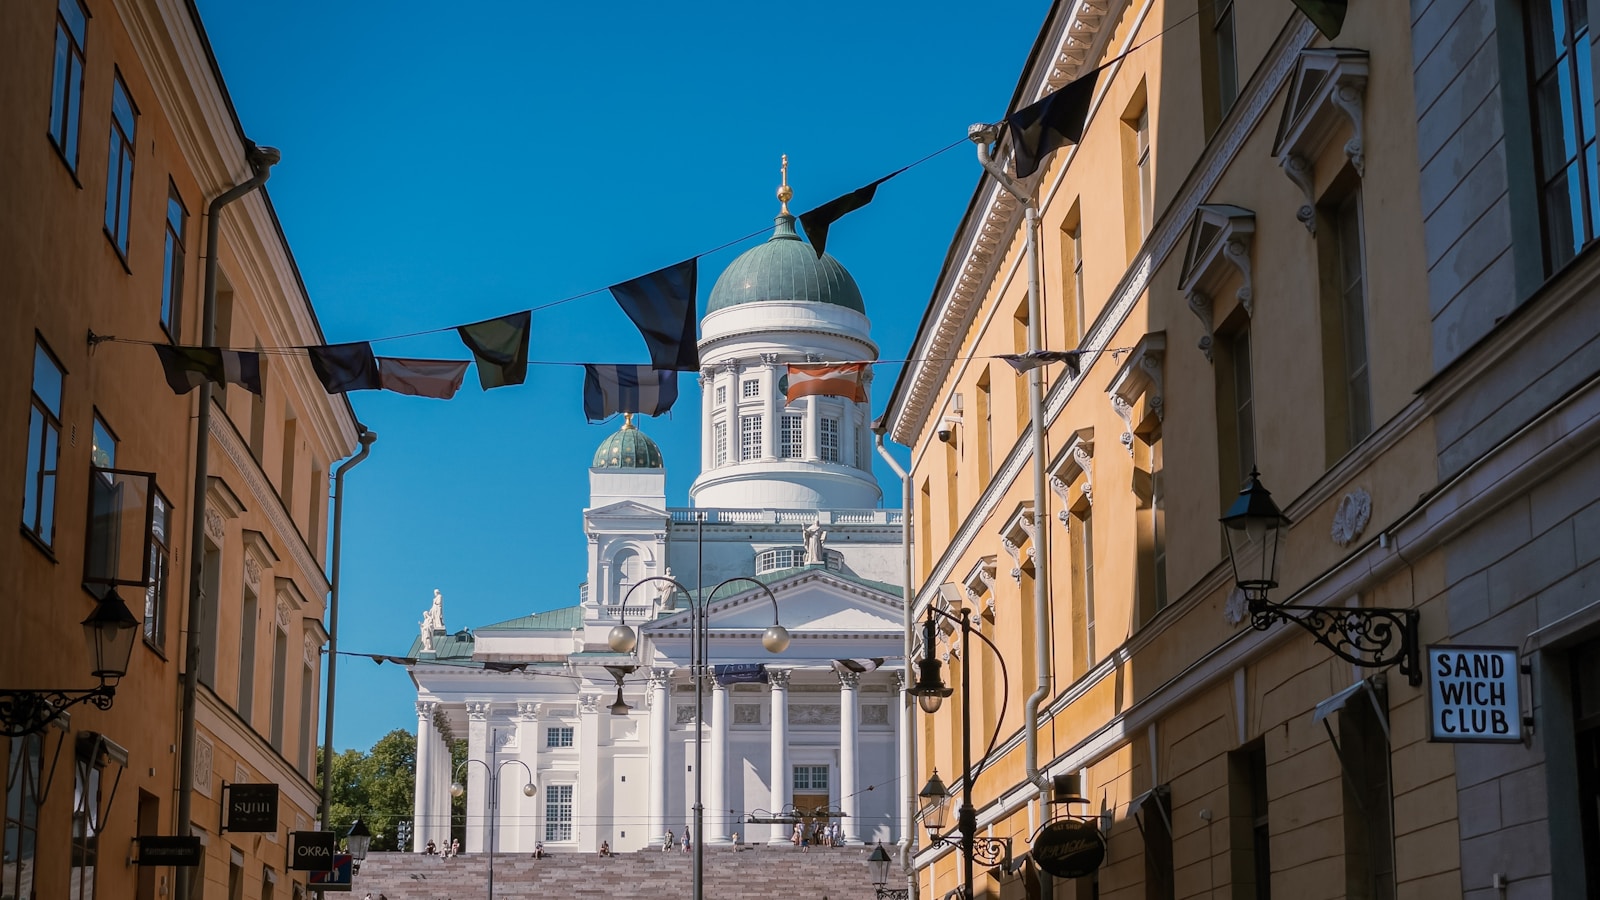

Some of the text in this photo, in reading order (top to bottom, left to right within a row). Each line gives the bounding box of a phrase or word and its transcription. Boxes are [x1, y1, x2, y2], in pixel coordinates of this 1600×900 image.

[1437, 653, 1504, 678] SAND
[1439, 681, 1505, 706] WICH
[1441, 708, 1509, 734] CLUB
[297, 845, 330, 857] OKRA
